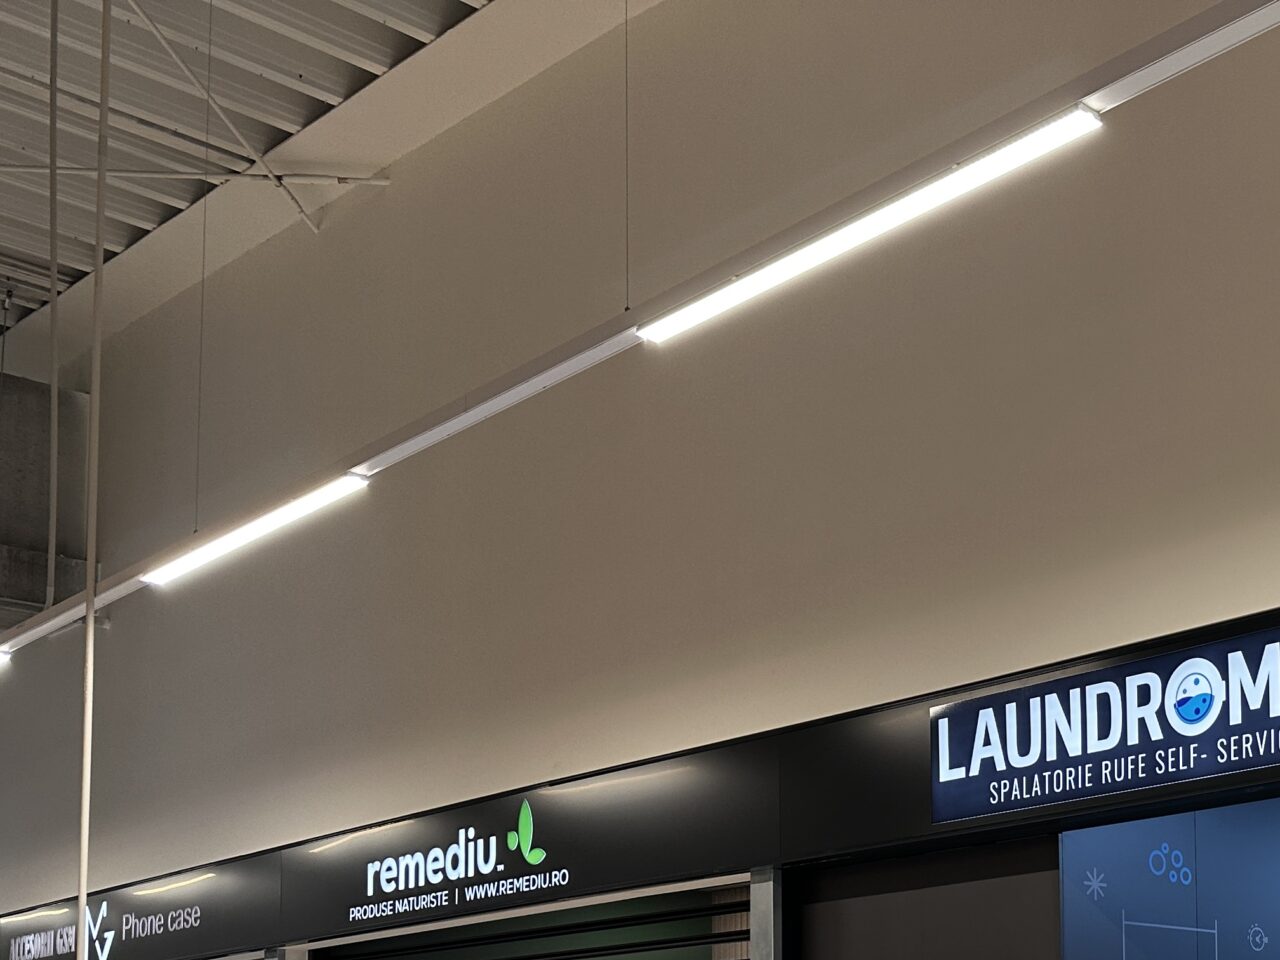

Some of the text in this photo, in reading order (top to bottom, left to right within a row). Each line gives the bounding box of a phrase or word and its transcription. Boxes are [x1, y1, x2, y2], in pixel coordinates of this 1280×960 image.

[989, 763, 1093, 805] SPALATORIE
[1101, 753, 1147, 785] RUFE
[366, 827, 498, 897] remediu
[349, 868, 570, 922] PRODUSE NATURISTE WWW.REMEDIU.RO
[122, 905, 201, 941] Phone case
